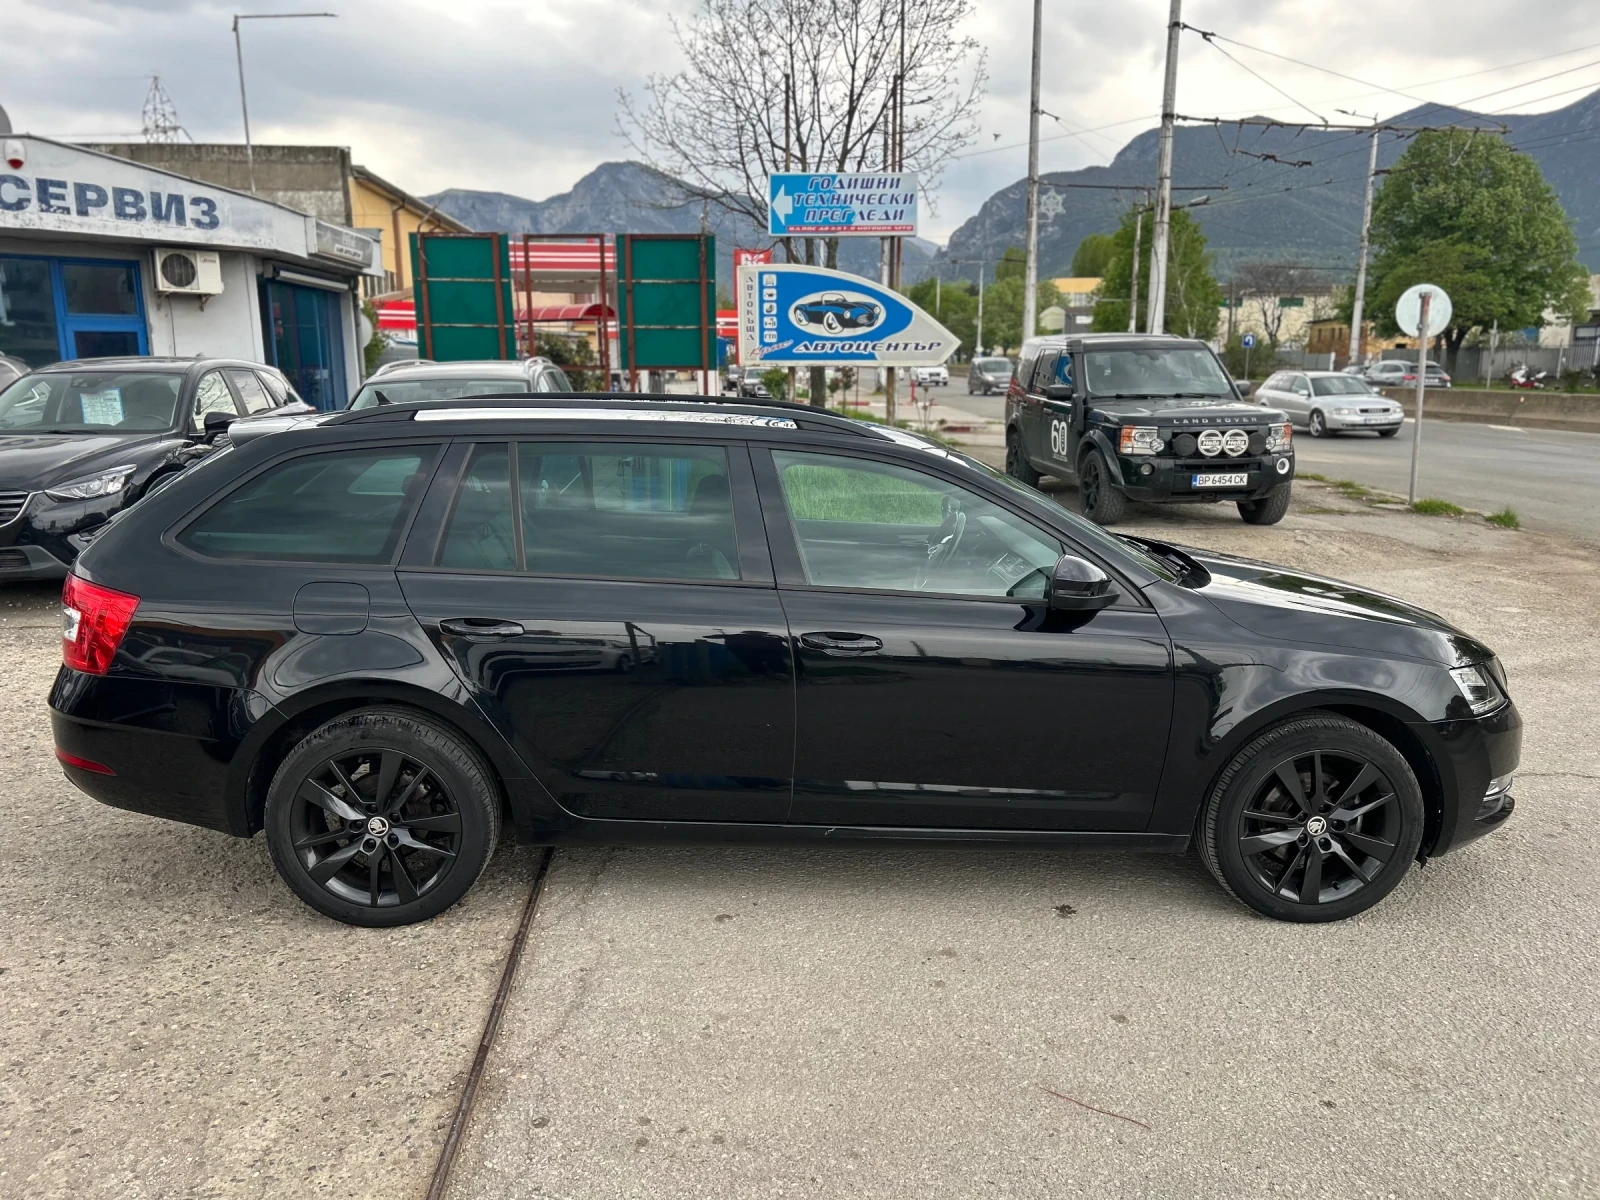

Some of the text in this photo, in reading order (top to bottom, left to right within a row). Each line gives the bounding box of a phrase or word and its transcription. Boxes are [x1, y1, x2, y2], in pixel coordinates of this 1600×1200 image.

[808, 177, 901, 190] ГОДИШНИ
[0, 174, 220, 230] СЕРВИЗ
[794, 193, 915, 206] ТЕХНИЧЕСКИ
[805, 209, 905, 221] ПРЕГЛЕДИ
[794, 341, 942, 353] АВТОЦЕНТЪР
[1051, 419, 1067, 456] 60
[1211, 475, 1233, 485] 6454
